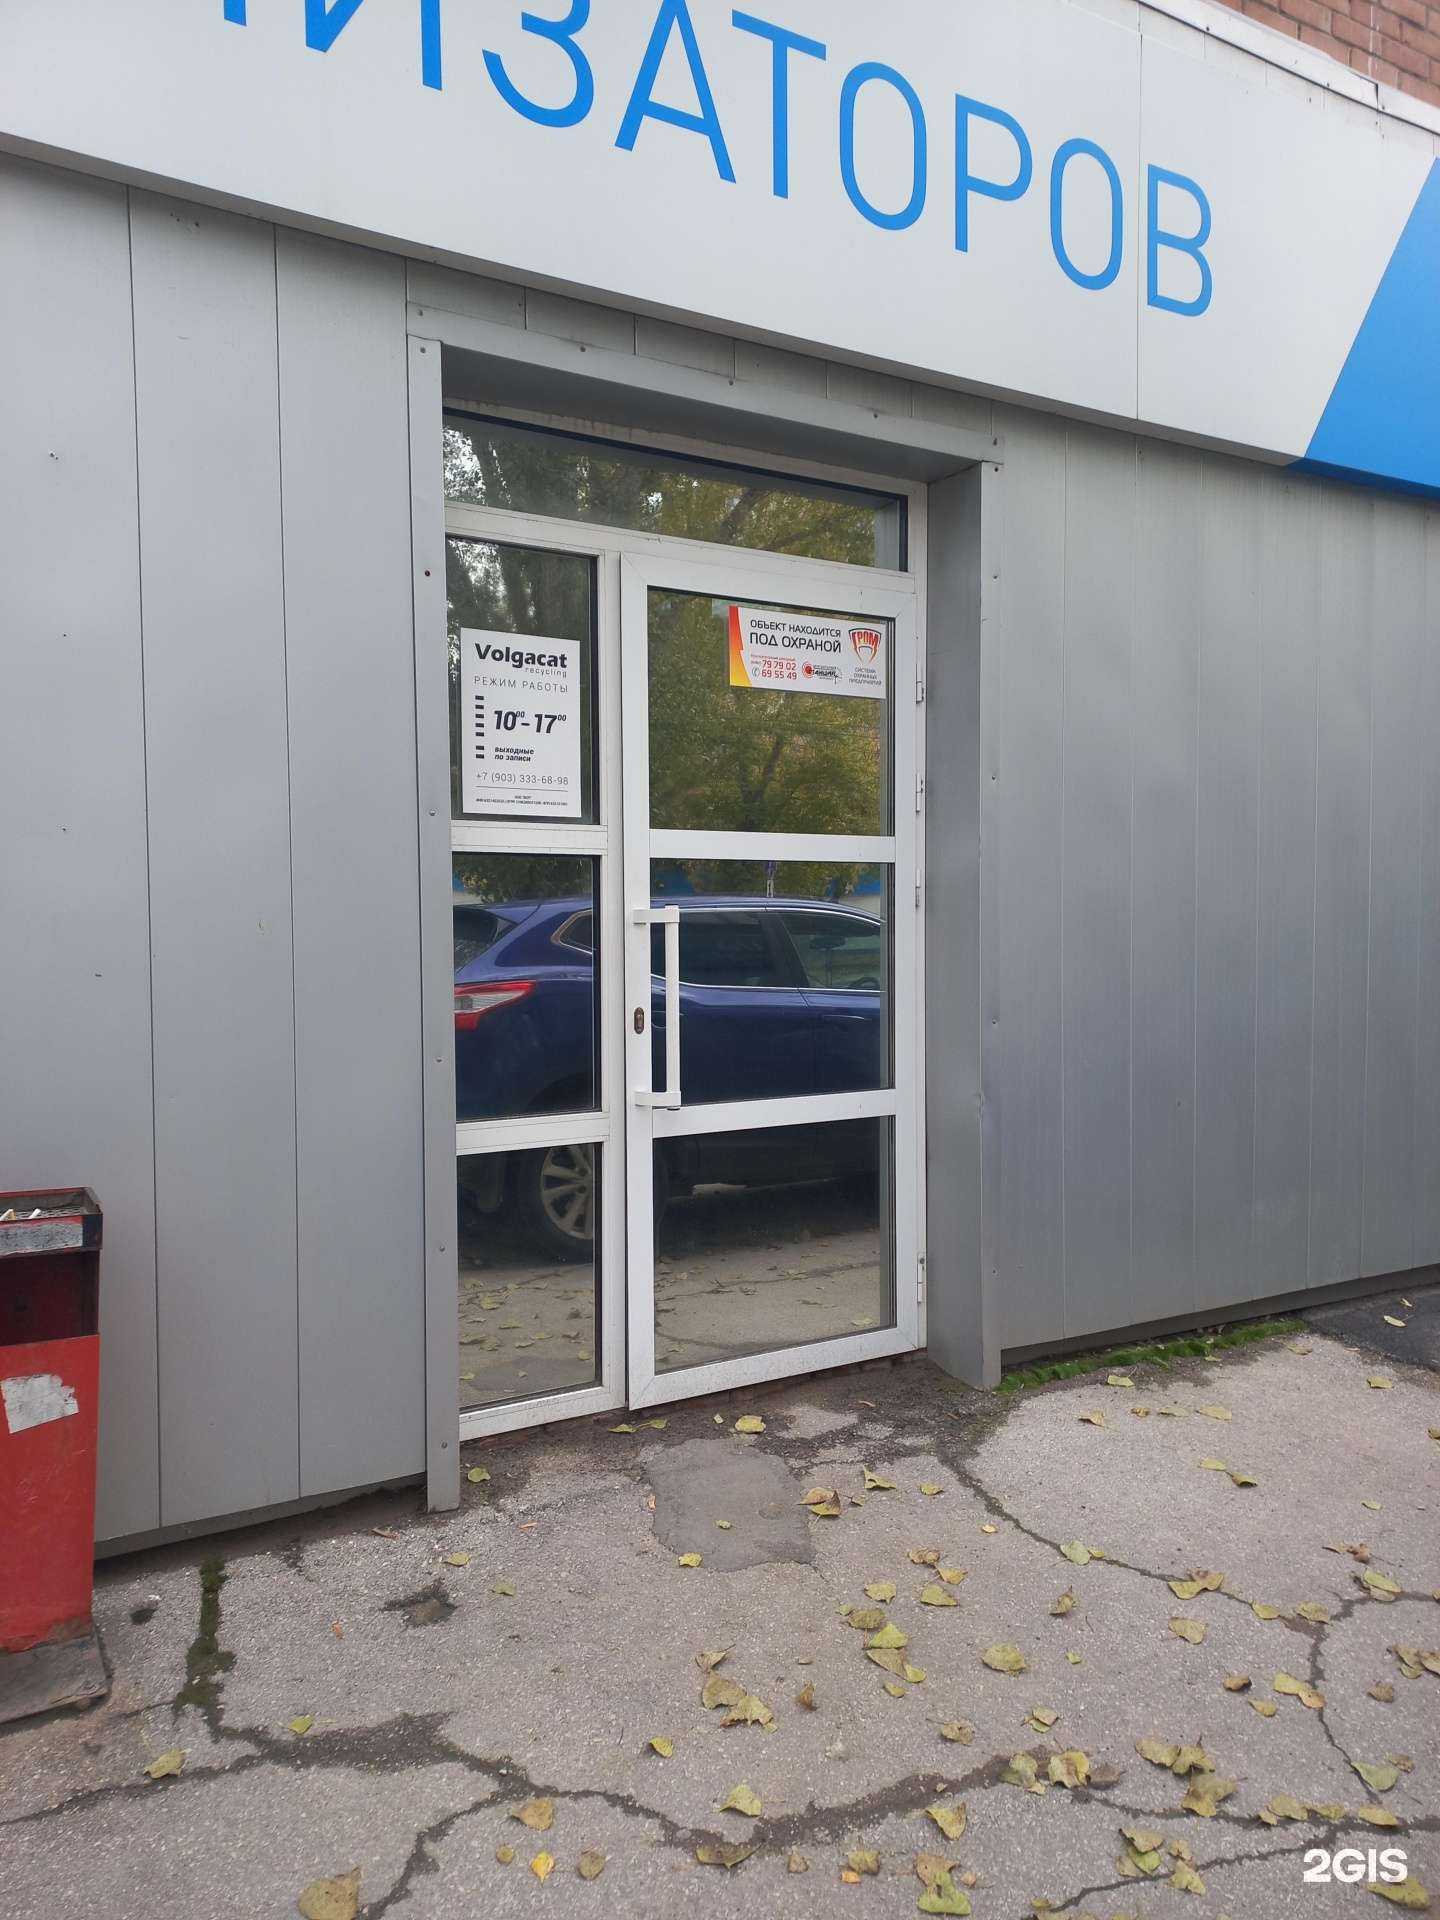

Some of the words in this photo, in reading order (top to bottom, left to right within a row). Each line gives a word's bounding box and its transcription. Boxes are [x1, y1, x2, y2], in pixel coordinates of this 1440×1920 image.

[750, 619, 787, 631] ОБЪЕКТ
[789, 625, 841, 638] НАХОДИТСЯ
[750, 632, 778, 646] ПОД
[782, 636, 841, 653] ОХРАНОЙ
[474, 643, 568, 669] Volgacat
[525, 667, 567, 679] recycling
[762, 660, 772, 669] 79
[774, 661, 784, 670] 79
[786, 662, 797, 671] 02
[761, 669, 773, 678] 69
[774, 670, 785, 679] 55
[787, 671, 797, 680] 49
[474, 675, 517, 689] РЕЖИМ
[522, 681, 568, 693] РАБОТЫ
[476, 771, 488, 781] +7
[491, 772, 516, 785] (903)
